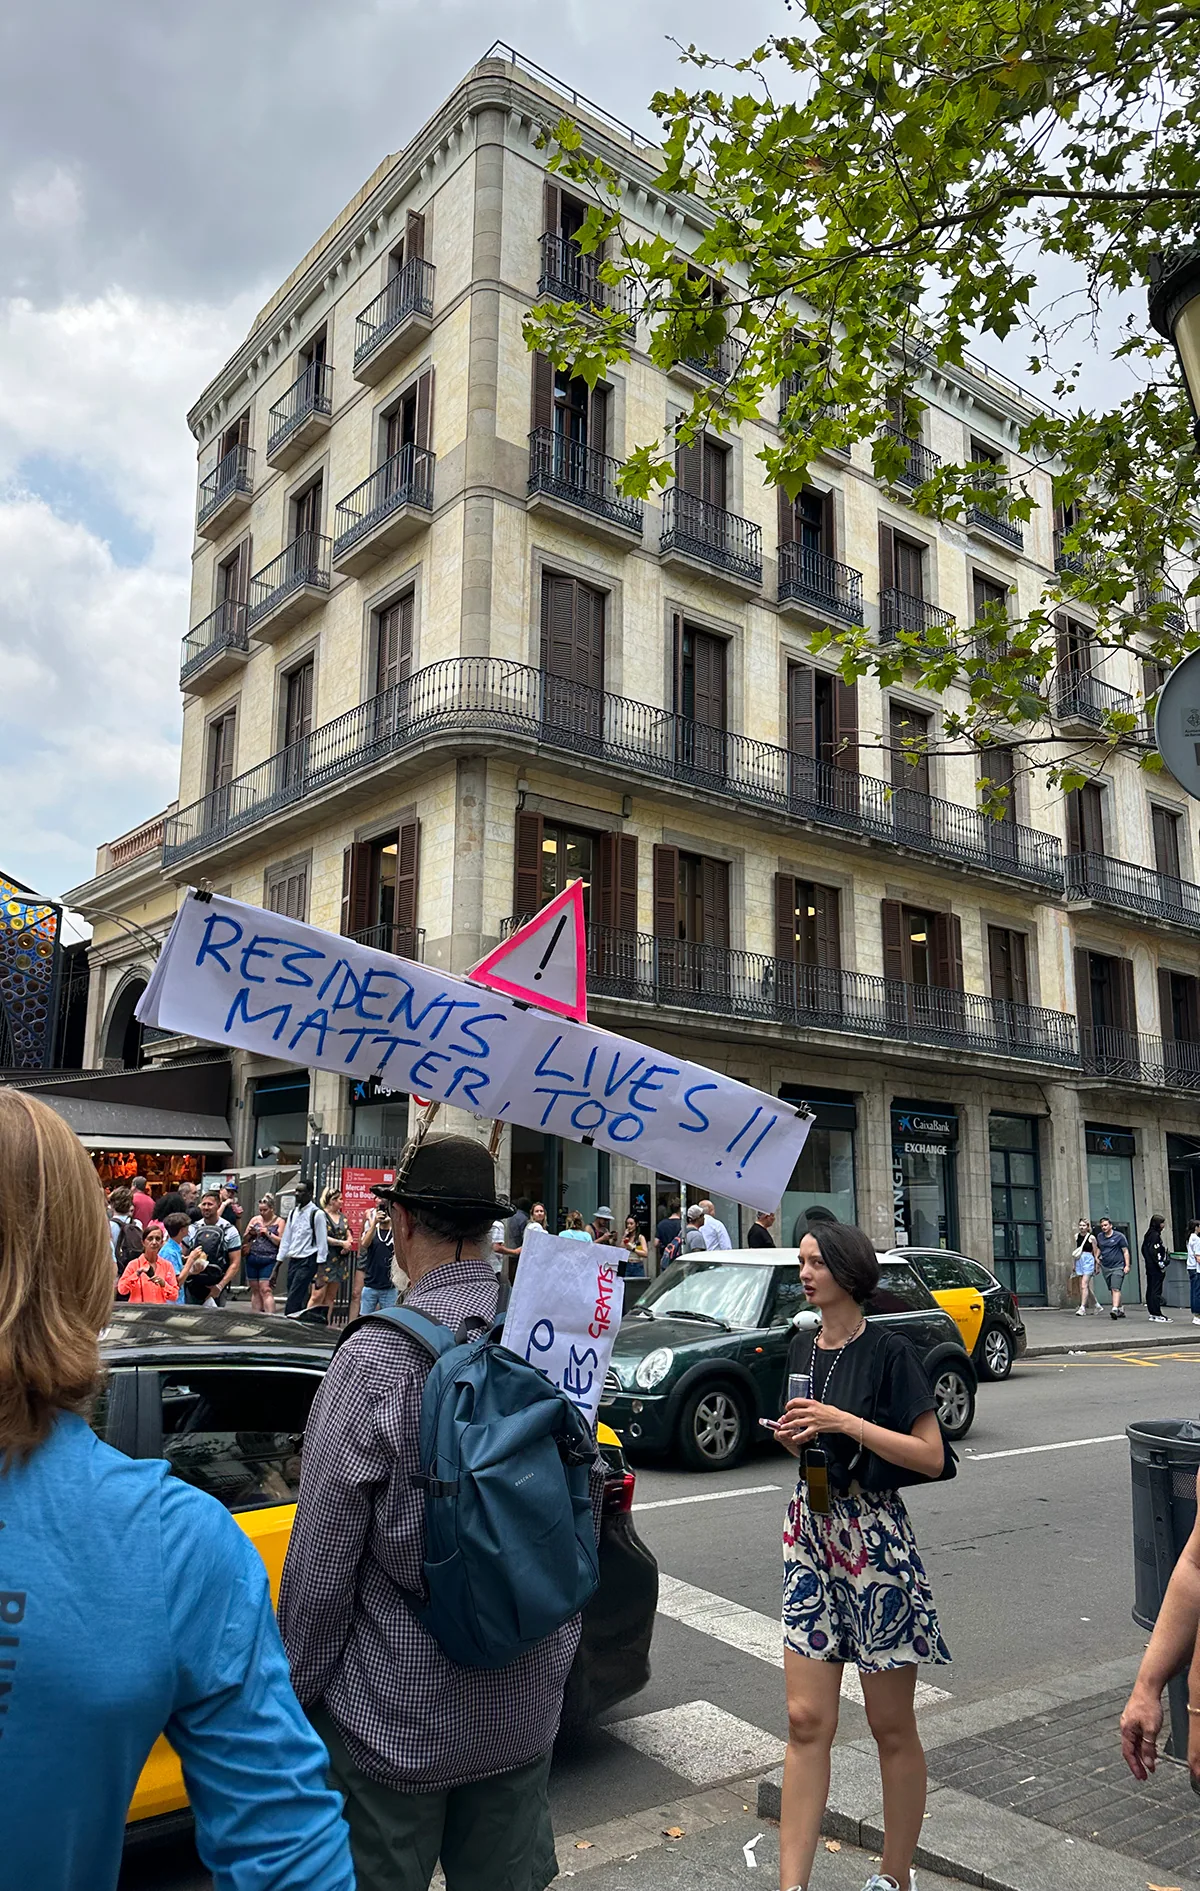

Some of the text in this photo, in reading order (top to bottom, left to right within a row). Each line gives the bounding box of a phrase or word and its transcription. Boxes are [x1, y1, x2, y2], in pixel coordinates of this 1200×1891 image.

[196, 912, 508, 1059] RESIDENTS
[533, 1087, 645, 1142] TOO
[913, 1117, 950, 1132] CaixaBank
[904, 1142, 948, 1155] EXCHANGE
[345, 1184, 366, 1192] Mercat
[345, 1191, 353, 1199] de
[588, 1260, 614, 1339] GRATIS
